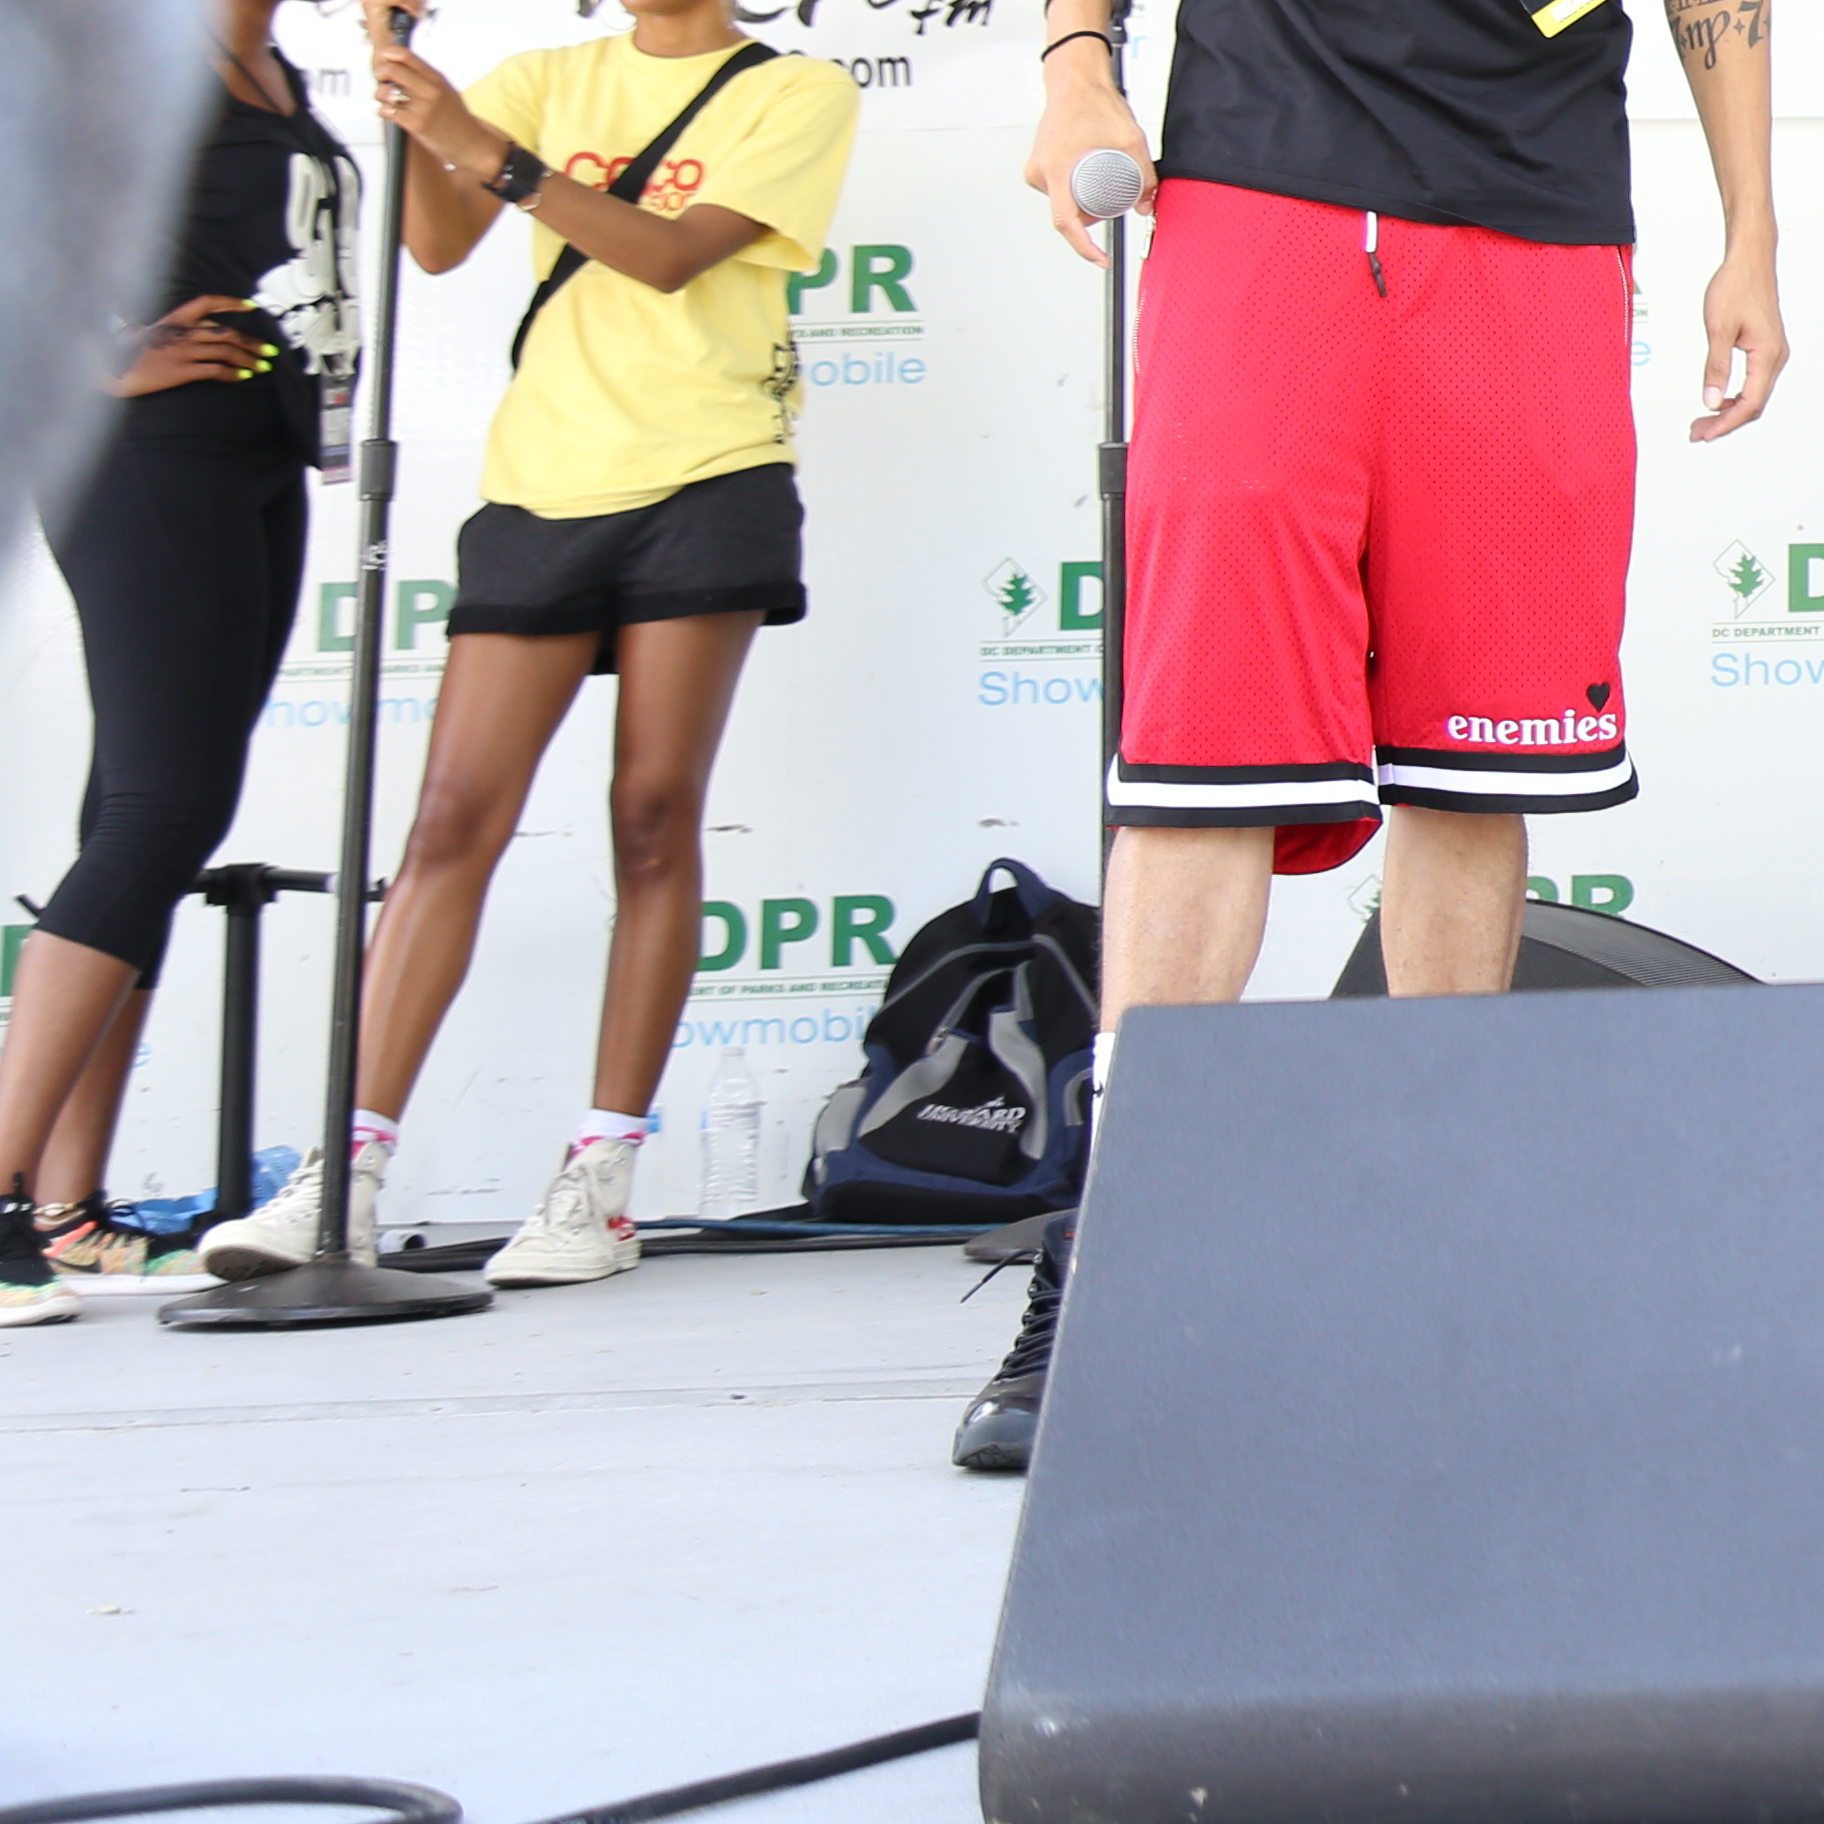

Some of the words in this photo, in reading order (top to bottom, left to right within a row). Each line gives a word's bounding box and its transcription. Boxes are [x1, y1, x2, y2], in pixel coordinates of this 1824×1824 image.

[787, 243, 918, 316] PR
[808, 351, 927, 387] obile
[1712, 628, 1730, 638] DC
[1734, 626, 1819, 637] DEPARTMENT
[1447, 709, 1618, 745] enemies
[696, 894, 898, 973] DPR
